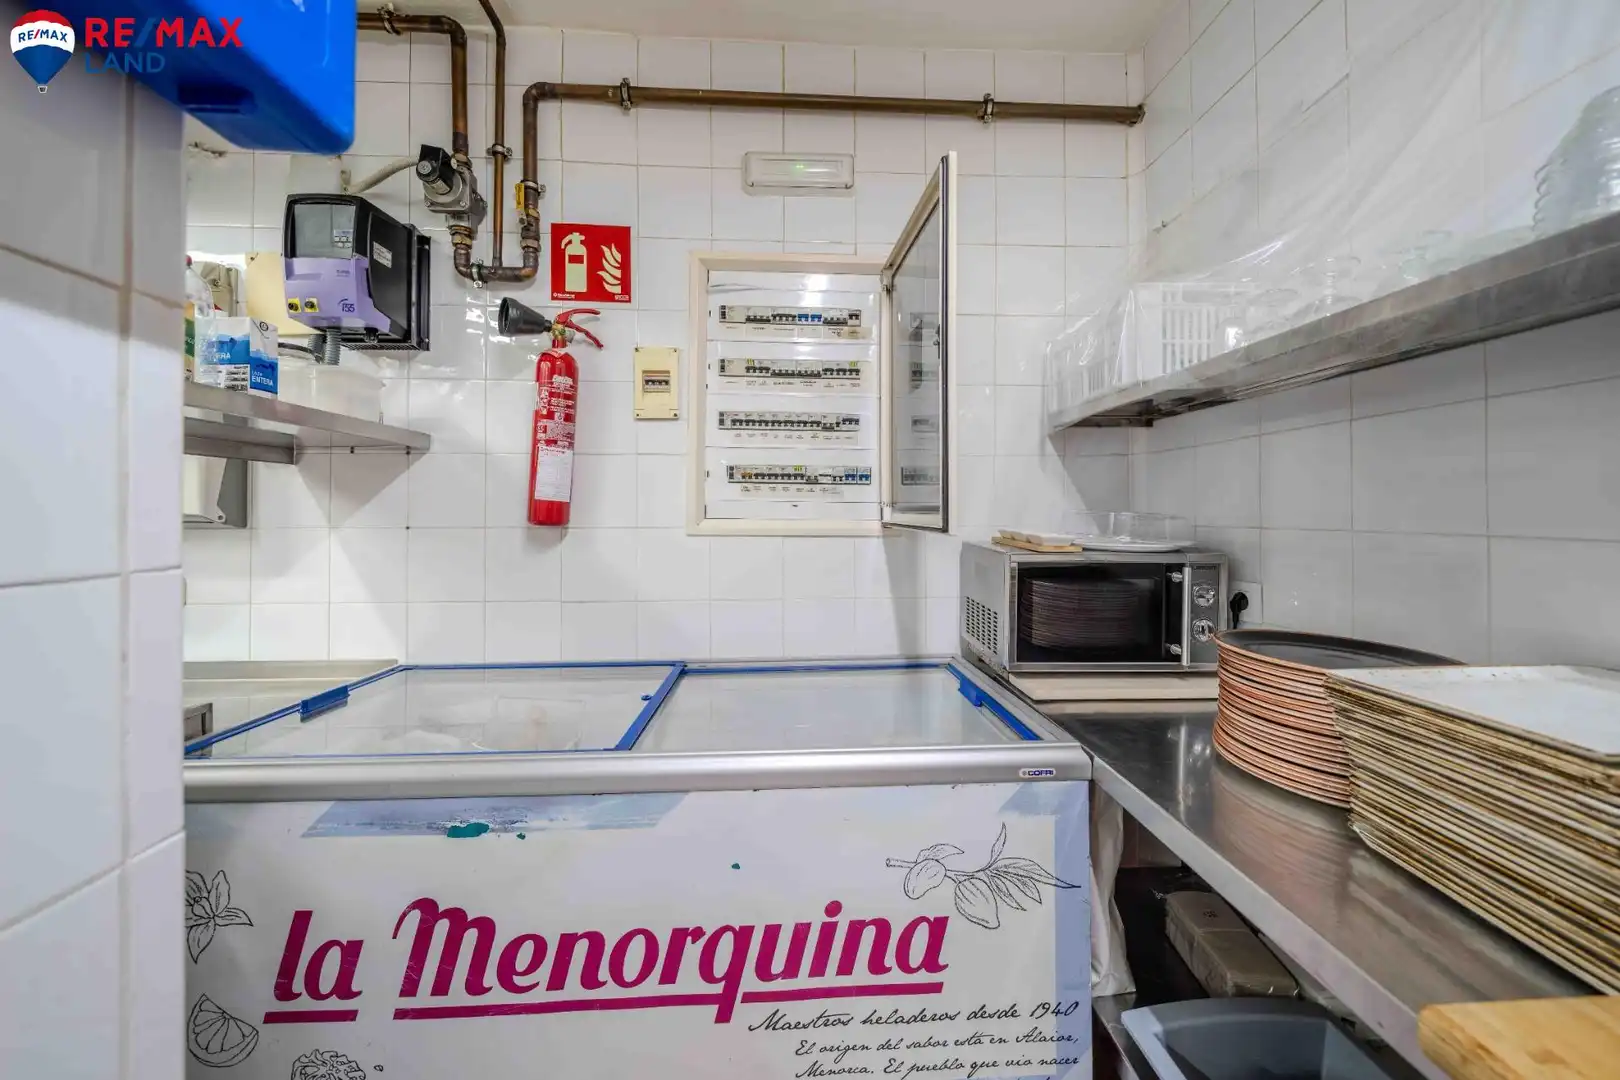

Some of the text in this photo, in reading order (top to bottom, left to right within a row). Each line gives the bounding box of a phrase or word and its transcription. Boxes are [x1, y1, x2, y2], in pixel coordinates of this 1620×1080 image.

[273, 897, 950, 1024] la Menorquina
[748, 1001, 1079, 1032] Maestros heladeros desde 1940
[795, 1039, 817, 1056] El
[819, 1040, 872, 1065] origen
[876, 1038, 903, 1051] del
[906, 1036, 949, 1049] sabor
[989, 1036, 1009, 1044] en
[795, 1055, 1080, 1080] Menorca. El pueblo que vio nacer
